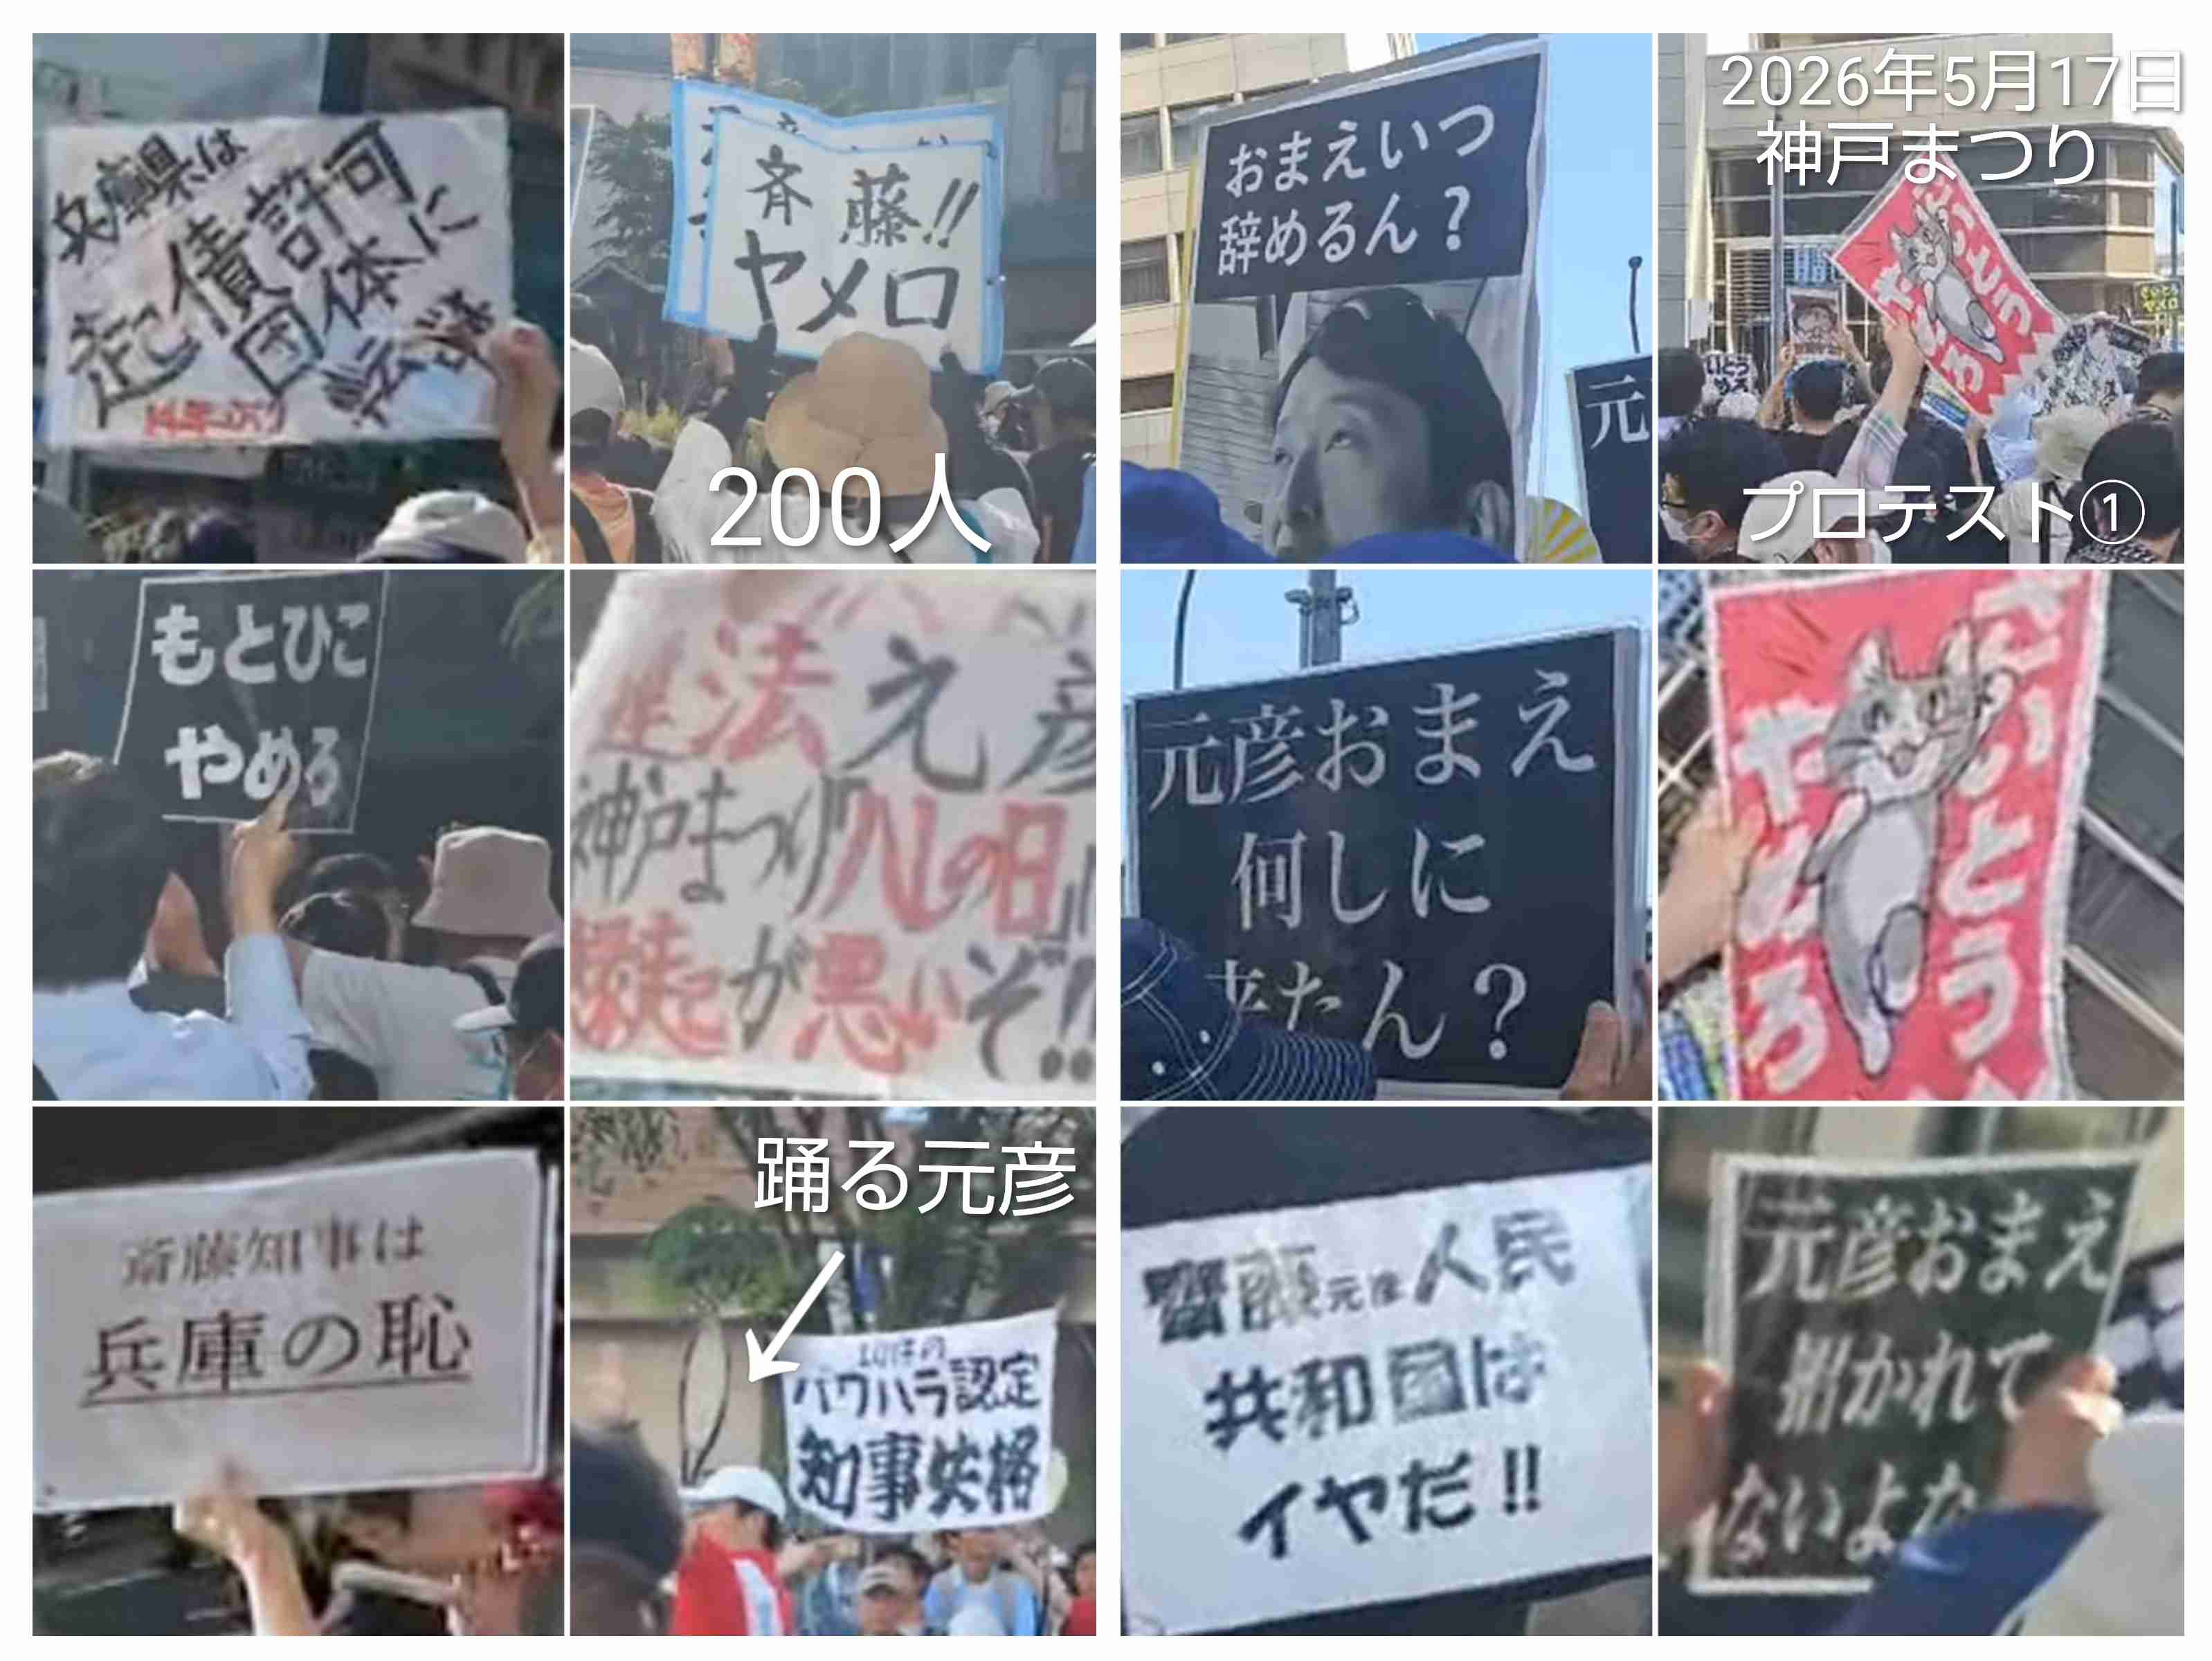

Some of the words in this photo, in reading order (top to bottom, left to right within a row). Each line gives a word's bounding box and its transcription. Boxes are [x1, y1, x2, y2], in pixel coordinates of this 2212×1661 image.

[1224, 104, 1496, 198] おまえいつ
[734, 229, 960, 332] ヤメロ
[1217, 185, 1471, 276] 辞めるん？
[1584, 374, 1651, 451] 元
[152, 603, 371, 686] もとひこ
[1142, 667, 1596, 811] 元彦おまえ
[1231, 829, 1492, 930] 何しに
[1741, 1186, 2114, 1302] 元彦おまえ
[82, 1291, 473, 1398] 兵庫の恥
[1204, 1330, 1548, 1451] 共和国は
